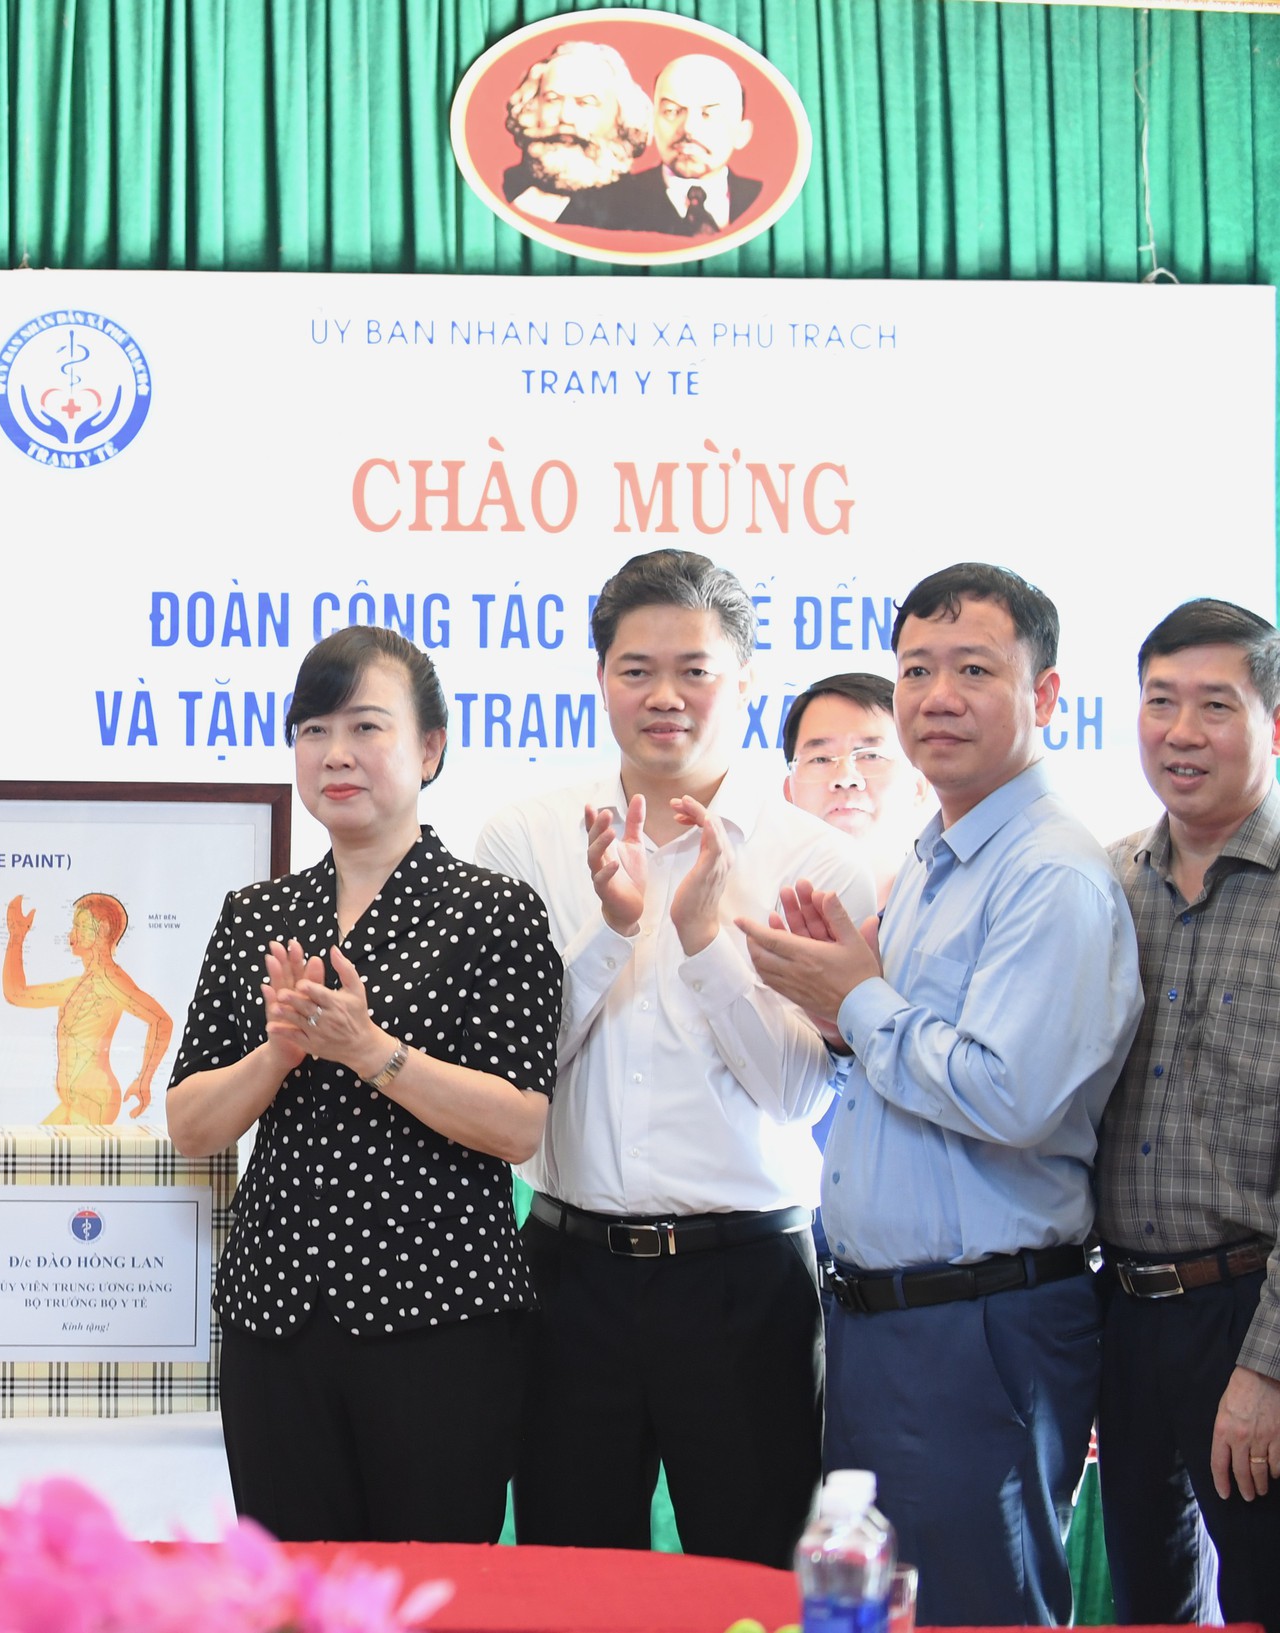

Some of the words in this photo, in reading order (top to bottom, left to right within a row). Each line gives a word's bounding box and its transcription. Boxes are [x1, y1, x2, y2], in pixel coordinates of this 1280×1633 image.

[367, 319, 434, 345] BAN
[635, 371, 651, 395] Y
[79, 451, 92, 467] Y
[351, 436, 578, 534] CHÀO
[613, 438, 856, 536] MỪNG
[149, 578, 289, 648] ĐOÀN
[313, 580, 450, 649] CÔNG
[472, 581, 564, 650] TÁC
[793, 575, 893, 650] ĐẾN
[95, 677, 158, 746] VÀ
[178, 677, 295, 761] TẶN
[455, 693, 596, 762] TRẠM
[11, 853, 72, 870] PAINT)
[9, 1255, 31, 1268] Đ/c
[36, 1251, 72, 1269] ĐÀO
[131, 1256, 165, 1269] LAN
[20, 1280, 49, 1292] VIÊN
[52, 1282, 95, 1292] TRUNG
[99, 1281, 135, 1293] ƯƠNG
[24, 1297, 41, 1310] BỘ
[101, 1297, 118, 1310] BỘ
[121, 1298, 130, 1308] Y
